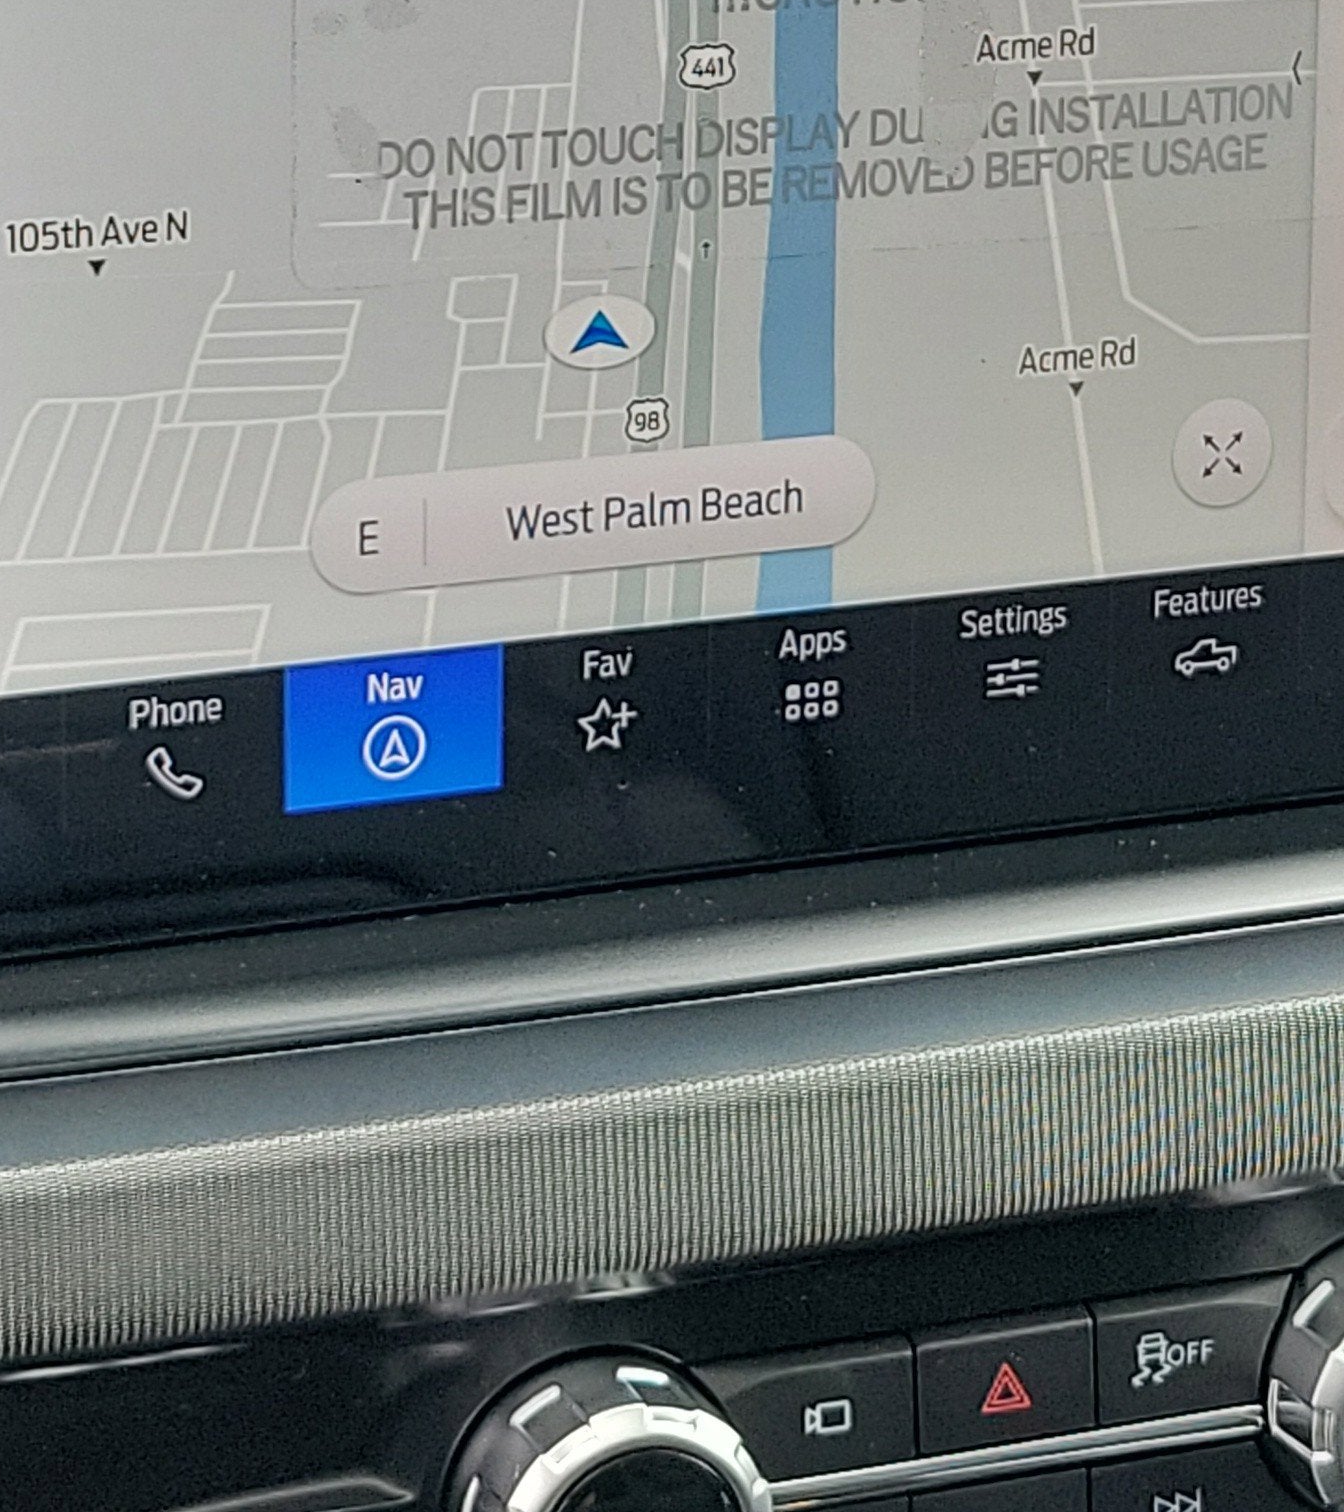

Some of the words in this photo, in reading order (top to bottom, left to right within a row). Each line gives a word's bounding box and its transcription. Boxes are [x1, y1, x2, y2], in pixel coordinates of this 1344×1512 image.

[977, 34, 1052, 62] Acme
[1060, 27, 1095, 56] Rd
[692, 58, 724, 77] 441
[378, 139, 434, 179] DO
[447, 133, 533, 175] NOT
[542, 123, 683, 168] TOUCH
[696, 111, 860, 158] DISPLAY
[870, 101, 1018, 146] DUG
[1030, 82, 1292, 135] INSTALLATION
[403, 187, 495, 230] THIS
[506, 179, 601, 223] FILM
[613, 176, 647, 216] IS
[656, 171, 711, 211] TO
[722, 167, 772, 208] BE
[985, 141, 1133, 189] BEFORE
[1142, 132, 1268, 177] USAGE
[6, 219, 94, 253] 105th
[101, 216, 157, 246] Ave
[166, 211, 188, 241] N
[1018, 345, 1094, 375] Acme
[1100, 337, 1136, 369] Rd
[634, 411, 660, 432] 98
[506, 500, 593, 541] West
[604, 493, 691, 532] Palm
[701, 478, 803, 522] Beach
[359, 520, 380, 555] E
[1153, 582, 1262, 619] Features
[959, 601, 1067, 639] Settings
[582, 647, 633, 679] Fav
[779, 627, 847, 663] Apps
[367, 671, 423, 705] Nav
[129, 693, 223, 730] Phone
[1167, 1338, 1215, 1366] OFF
